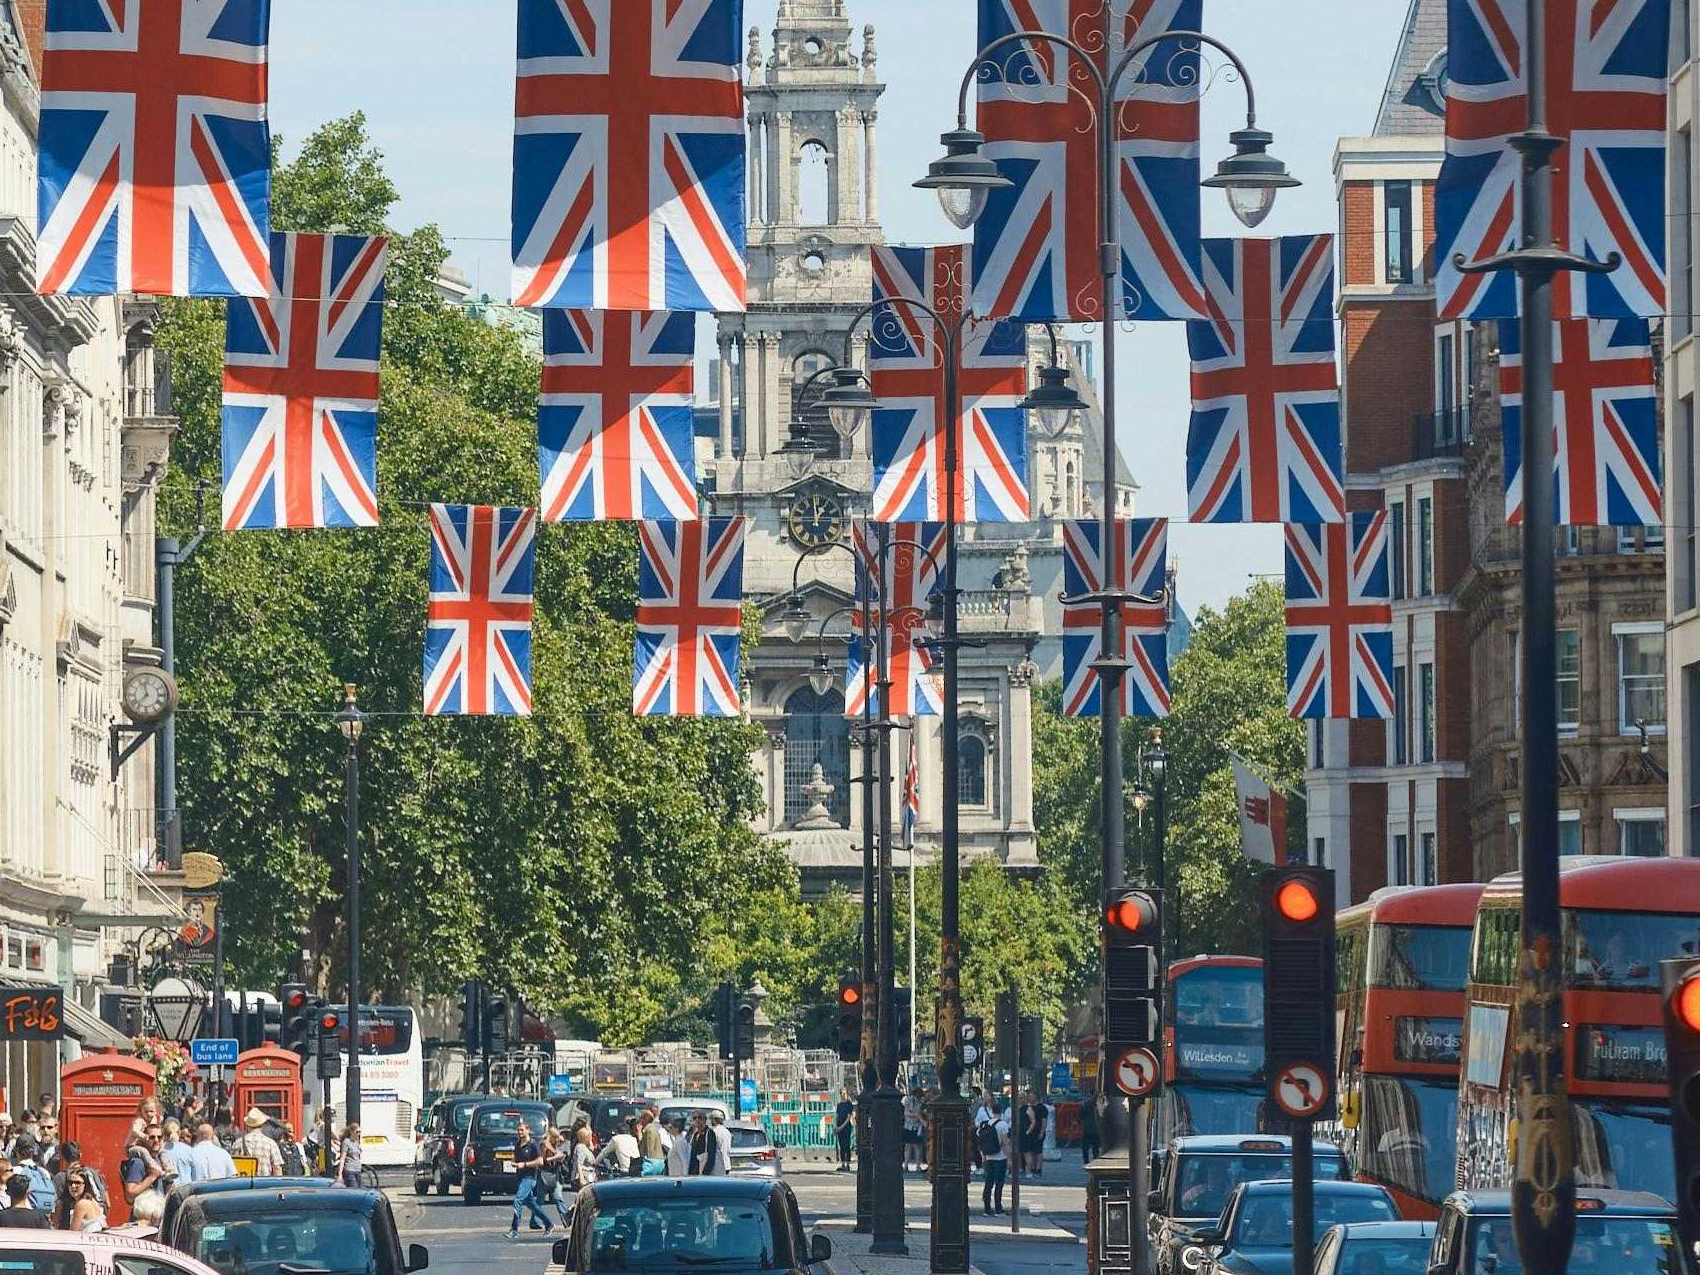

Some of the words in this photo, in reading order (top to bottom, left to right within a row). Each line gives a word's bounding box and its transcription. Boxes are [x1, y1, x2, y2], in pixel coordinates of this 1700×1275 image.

[201, 1044, 217, 1052] End
[1645, 1040, 1667, 1060] Bro
[1183, 1050, 1233, 1062] Willesden
